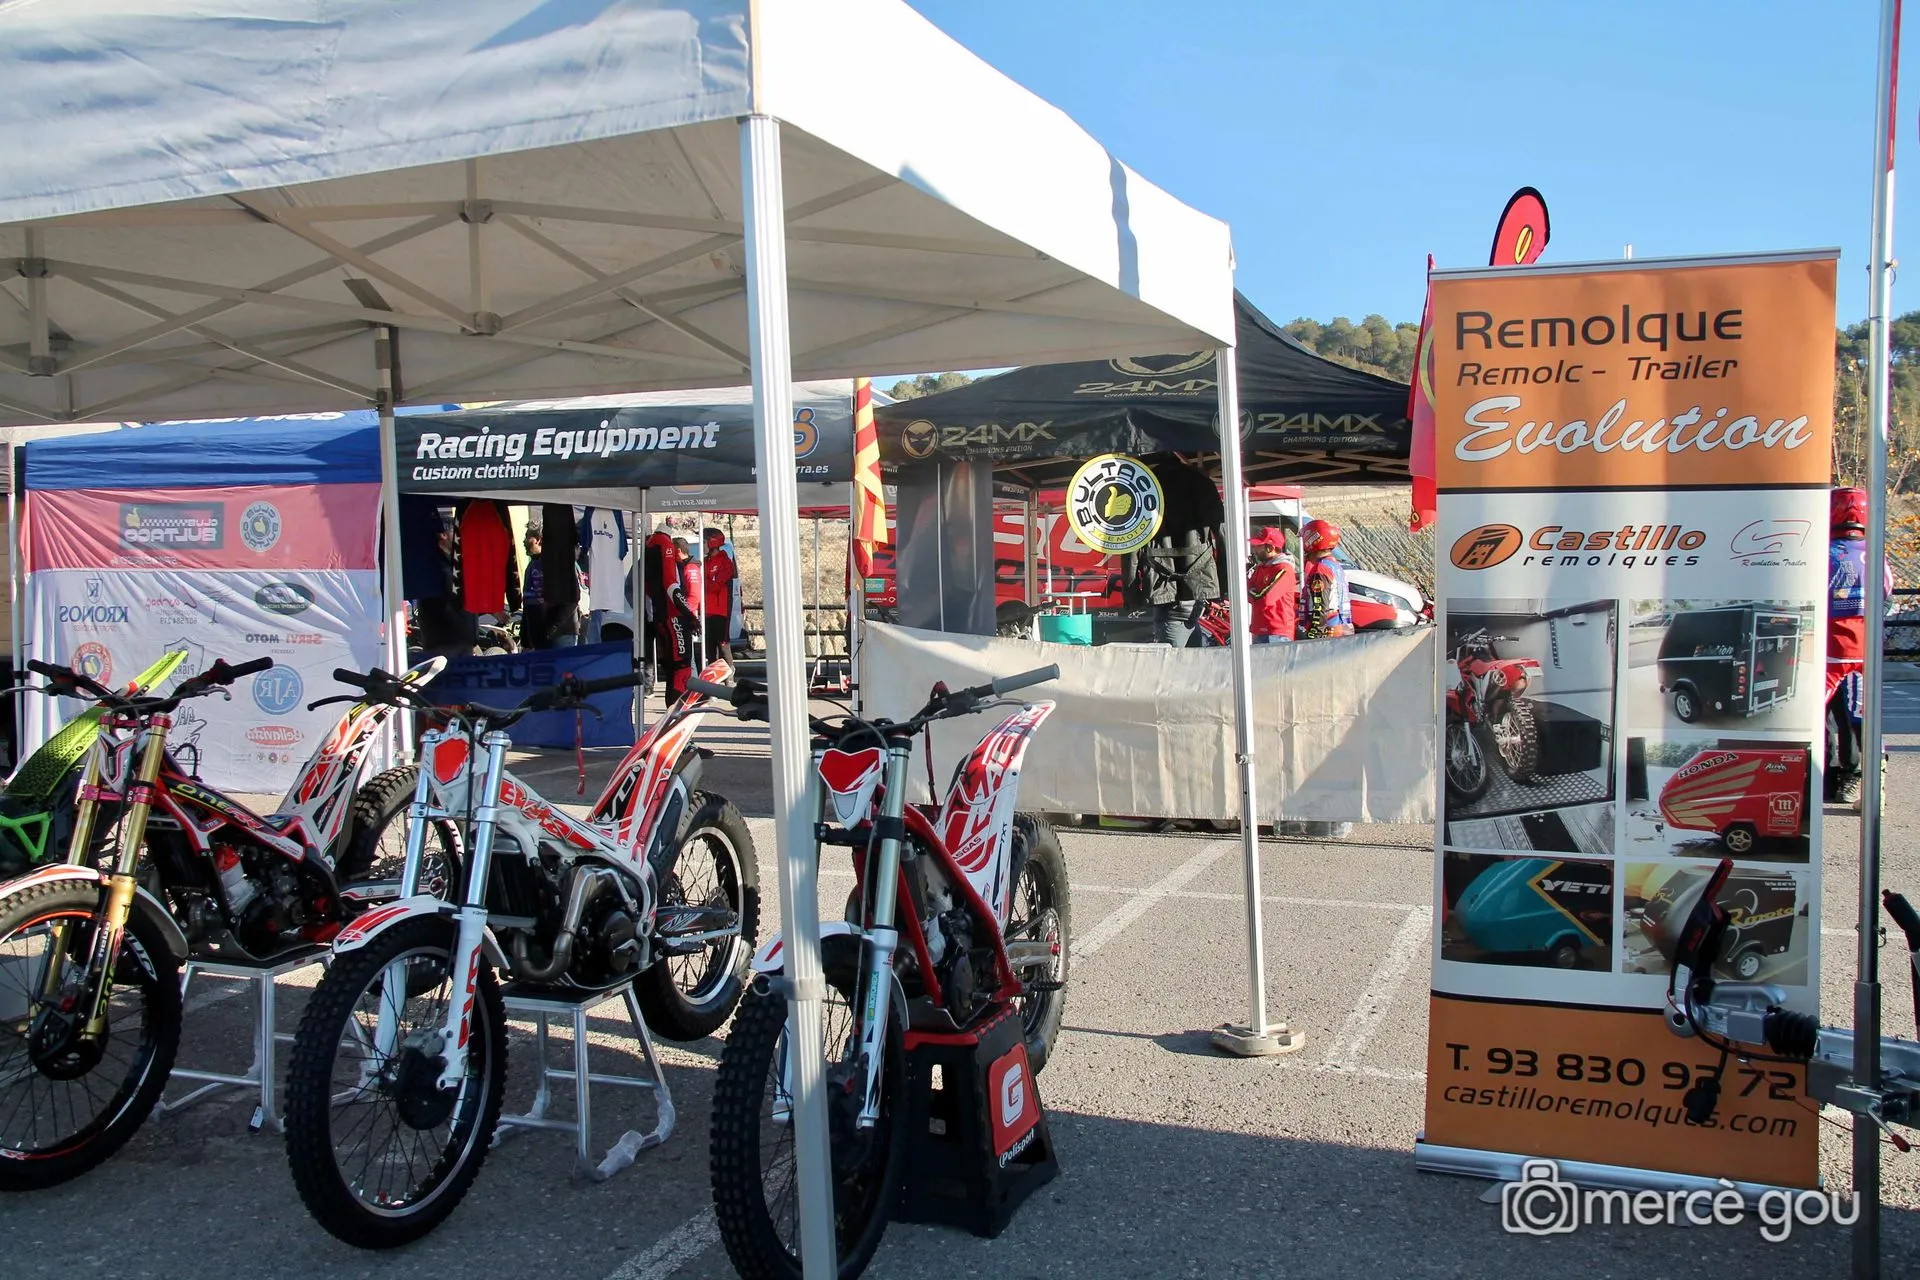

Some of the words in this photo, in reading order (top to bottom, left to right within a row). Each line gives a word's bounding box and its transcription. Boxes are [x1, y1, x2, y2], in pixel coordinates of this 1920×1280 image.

[1455, 303, 1743, 352] Remolque
[1456, 359, 1583, 387] Remolc
[1627, 354, 1738, 381] Trailer
[941, 419, 1057, 447] 24MX
[1255, 412, 1386, 434] 24MX
[1453, 395, 1813, 463] Evolution
[416, 425, 527, 462] Racing
[531, 419, 720, 458] Equipment
[1282, 436, 1327, 444] CHAMPIONS
[412, 461, 472, 481] Custom
[474, 461, 540, 481] clothing
[1075, 461, 1157, 528] BULTACO
[1528, 524, 1707, 552] Castillo
[1523, 552, 1701, 570] remolques
[1783, 557, 1808, 567] Trailer
[1678, 751, 1739, 780] HONDA
[1541, 879, 1611, 895] YETI
[1446, 1042, 1470, 1073] T.
[1486, 1047, 1540, 1077] 93
[1556, 1053, 1646, 1087] 830
[1737, 1068, 1797, 1100] 72
[1001, 1128, 1035, 1166] Polisport
